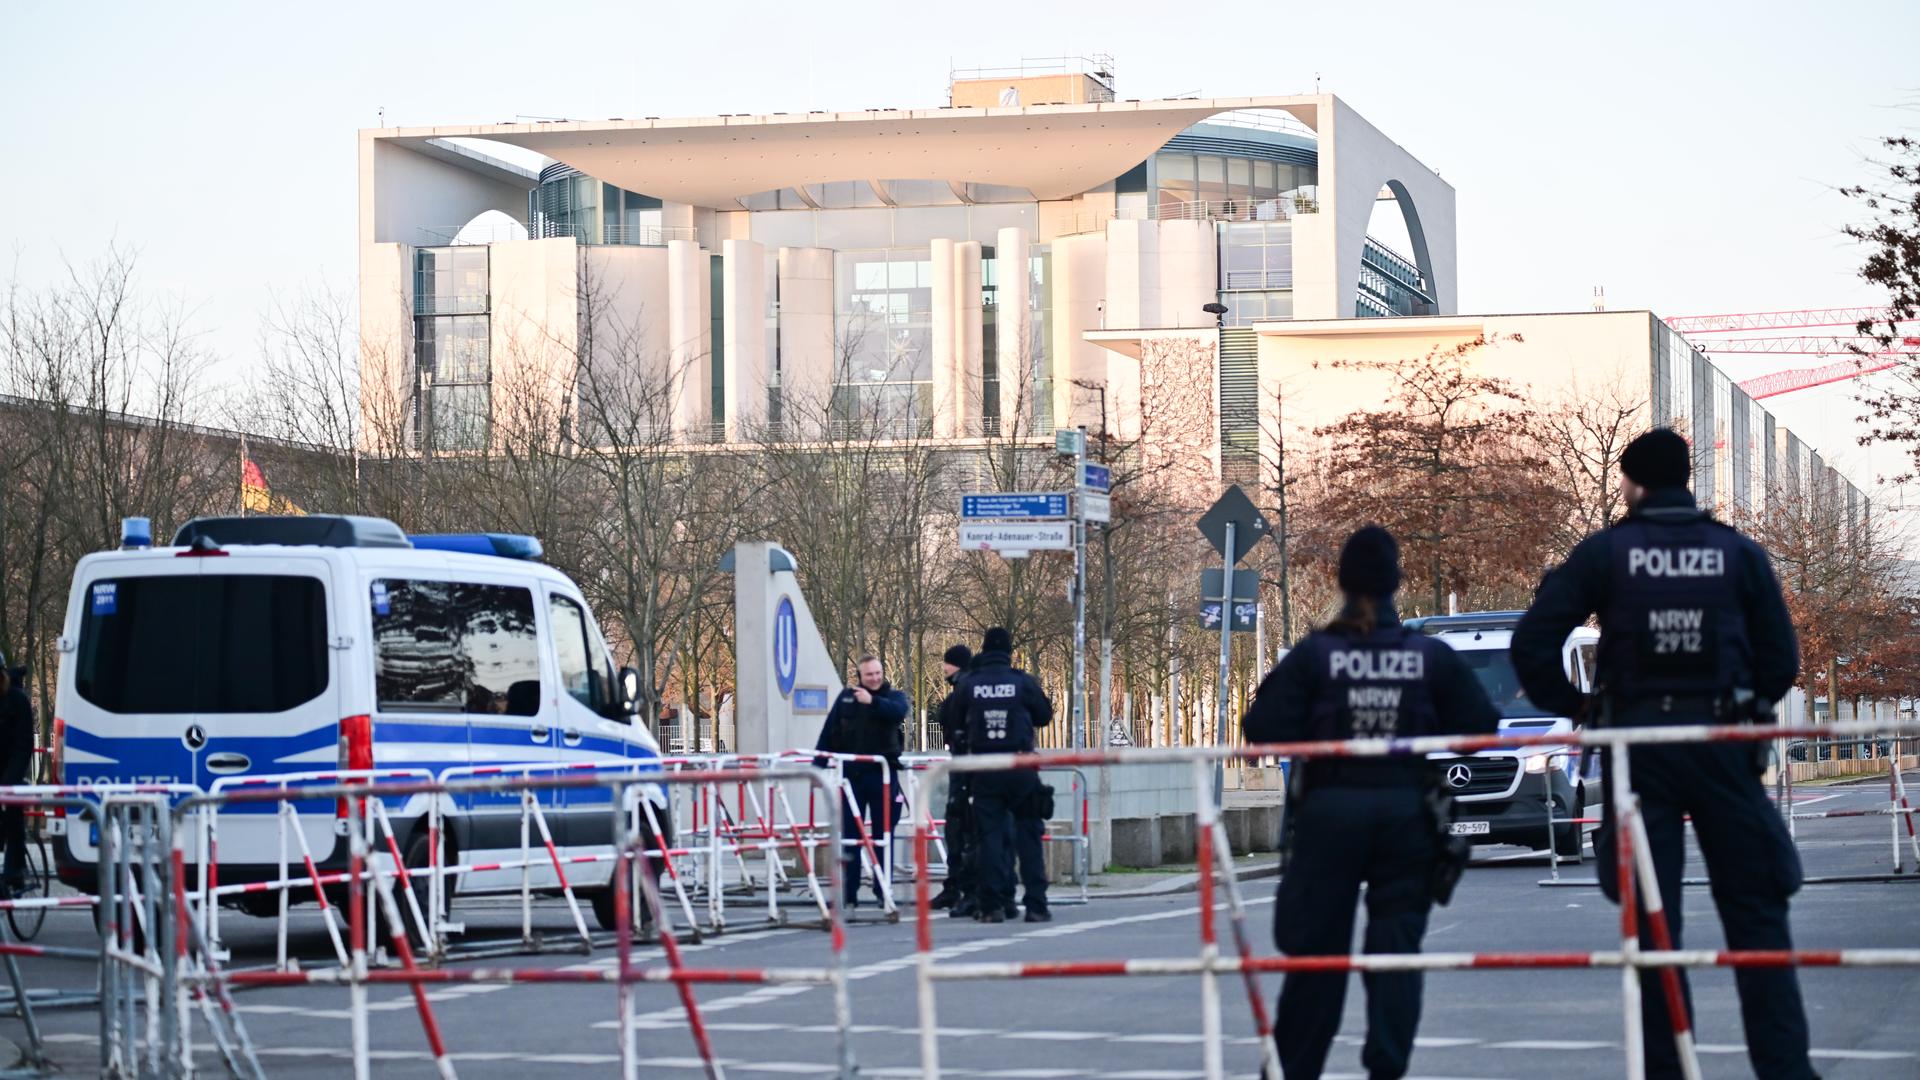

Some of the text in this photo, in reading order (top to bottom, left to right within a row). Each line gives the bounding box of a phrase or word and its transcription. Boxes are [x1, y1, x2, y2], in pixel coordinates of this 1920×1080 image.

[967, 531, 1063, 541] Konrad-Adenauer-Straße
[1629, 548, 1724, 577] POLIZEI
[93, 583, 116, 594] NRW
[1649, 608, 1703, 631] NRW
[779, 615, 792, 678] U
[1654, 631, 1702, 653] 2912
[1330, 650, 1424, 679] POLIZEI
[974, 684, 1016, 698] POLIZEI
[1348, 686, 1402, 708] NRW
[984, 710, 1008, 719] NRW
[1352, 709, 1399, 730] 2912
